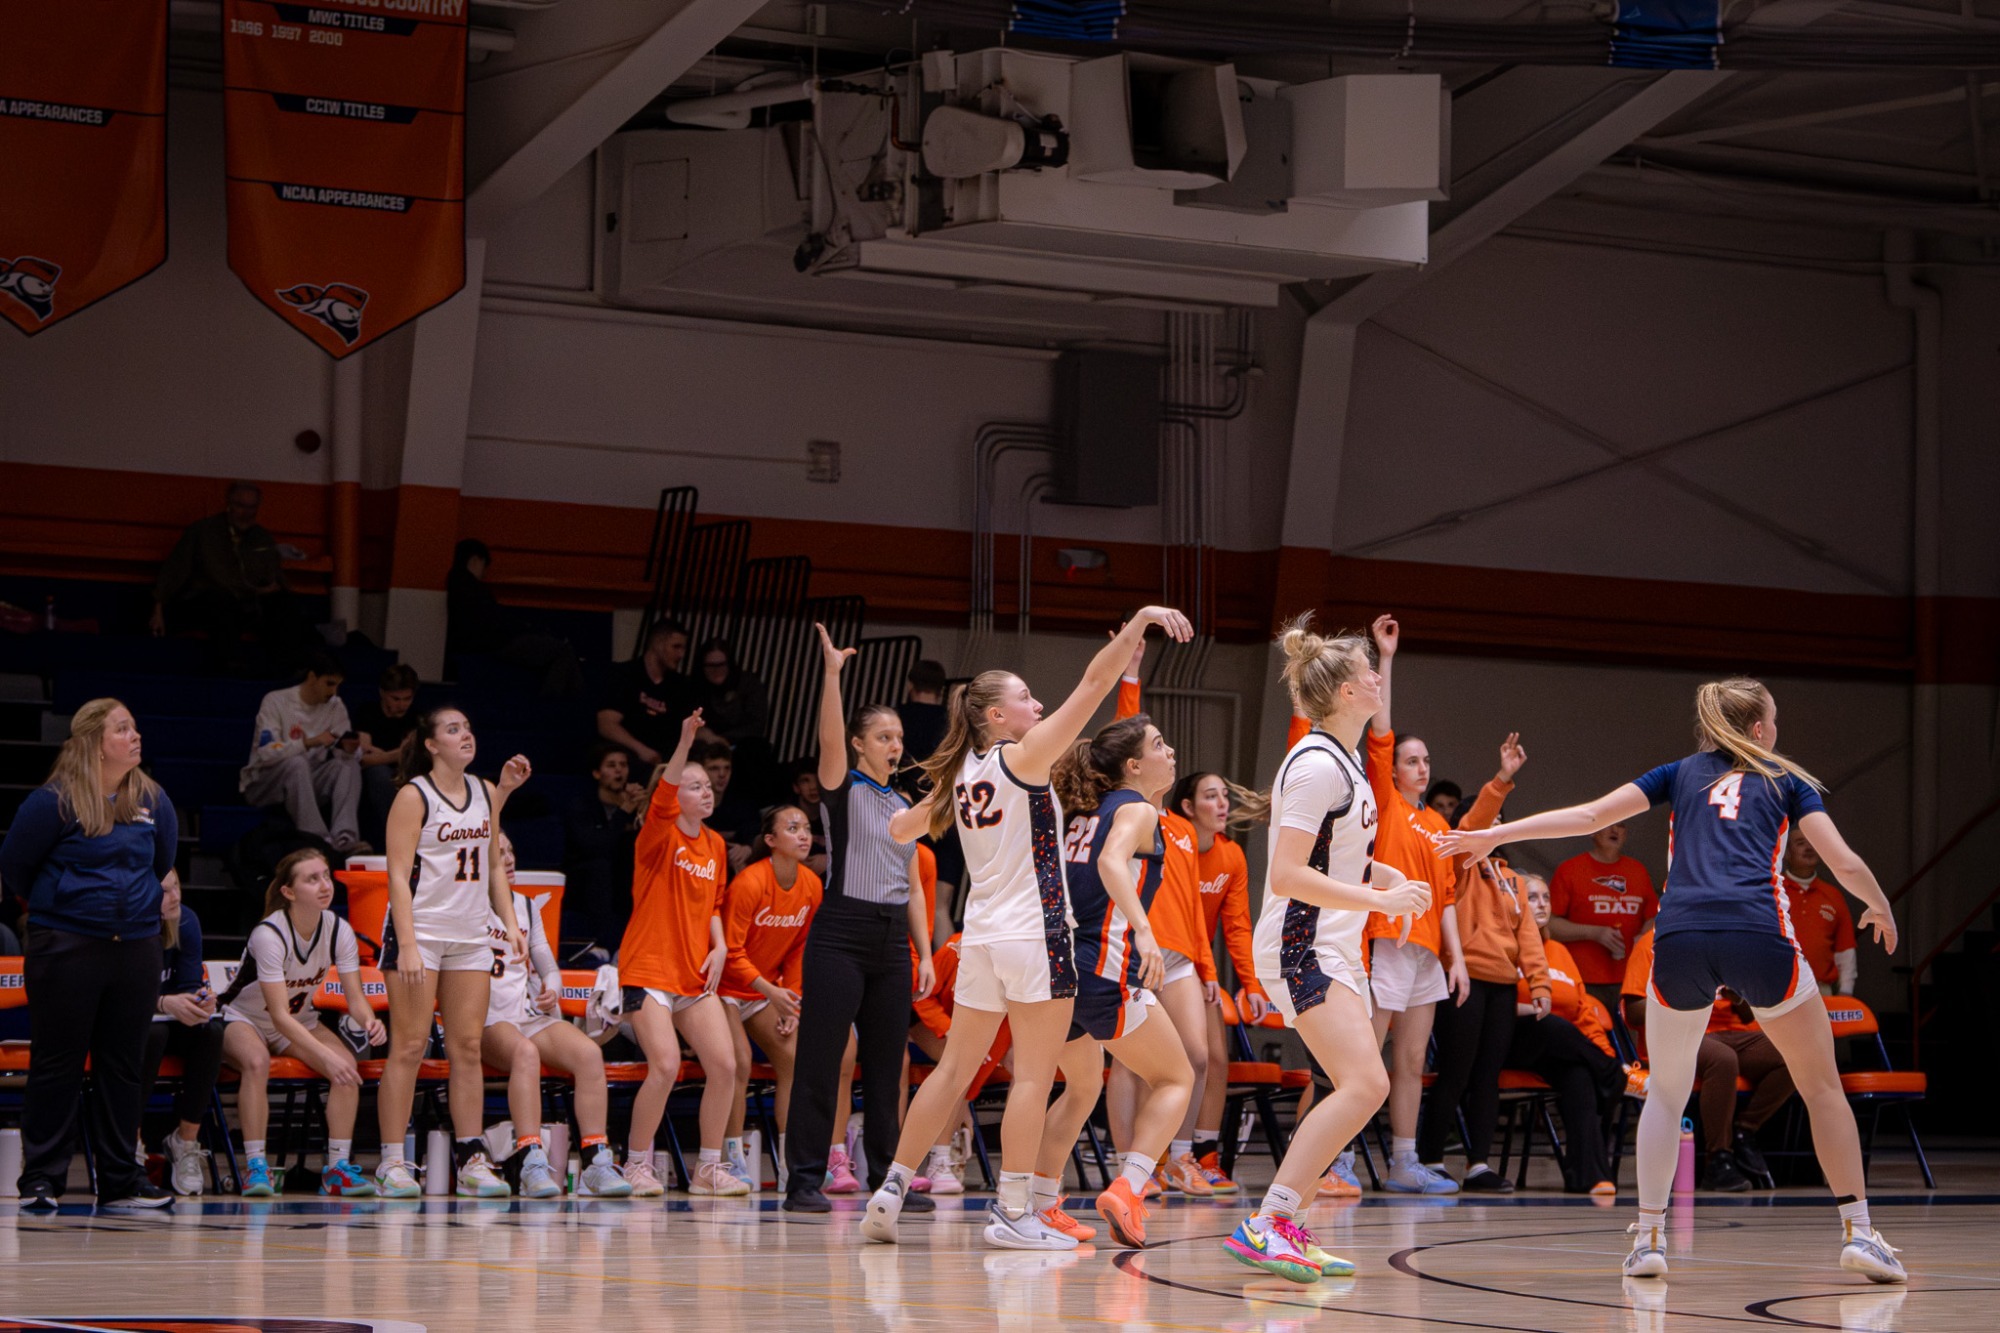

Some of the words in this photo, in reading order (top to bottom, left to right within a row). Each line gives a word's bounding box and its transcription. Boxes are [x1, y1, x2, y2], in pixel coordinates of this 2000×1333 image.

[307, 9, 341, 26] MWC
[342, 13, 386, 32] TITLES
[308, 29, 344, 47] 2000
[8, 99, 104, 125] APPEARANCES
[305, 97, 341, 116] CCIW
[342, 101, 386, 121] TITLES
[281, 184, 317, 202] NCAA
[317, 187, 406, 212] APPEARANCES
[1707, 771, 1745, 821] 4
[1064, 815, 1100, 864] 22
[454, 846, 480, 882] 11
[1199, 872, 1230, 895] roll
[754, 905, 811, 928] Carroll
[1593, 901, 1640, 915] DAD
